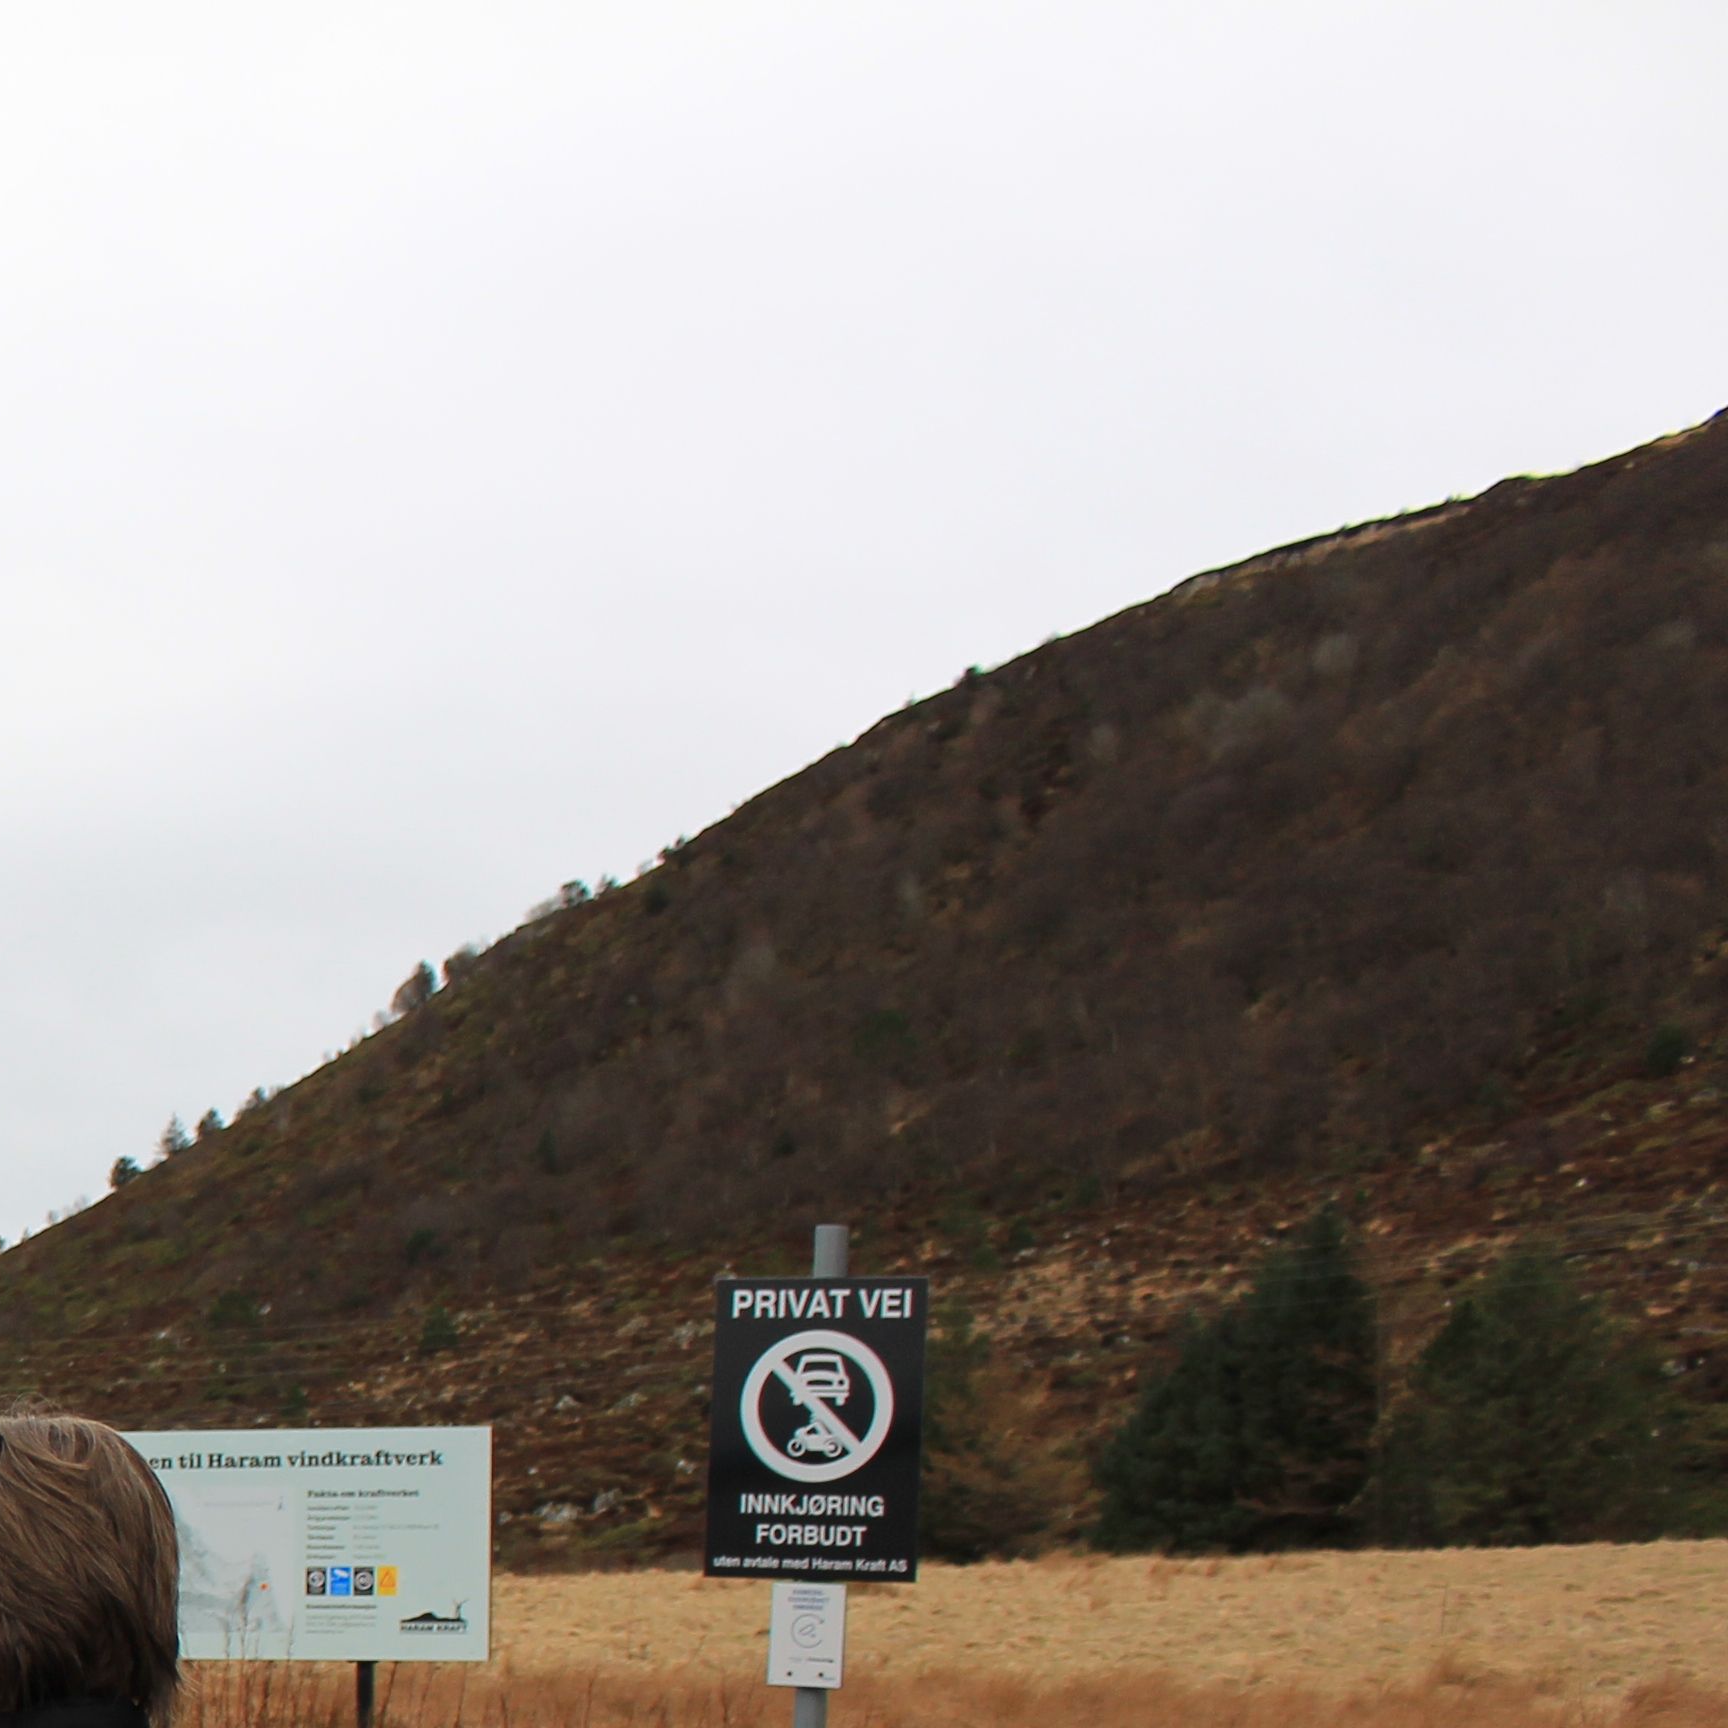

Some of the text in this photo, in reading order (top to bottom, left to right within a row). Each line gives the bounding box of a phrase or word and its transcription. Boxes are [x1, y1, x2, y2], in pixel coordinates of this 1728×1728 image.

[732, 1288, 913, 1319] PRIVAT VEI
[178, 1453, 202, 1469] til
[207, 1453, 282, 1469] Haram
[287, 1450, 443, 1467] vindkraftverk
[740, 1493, 885, 1517] INNKJØRING
[755, 1524, 867, 1546] FORBUDT
[713, 1555, 908, 1573] uten avtale med Haram Kraft AS
